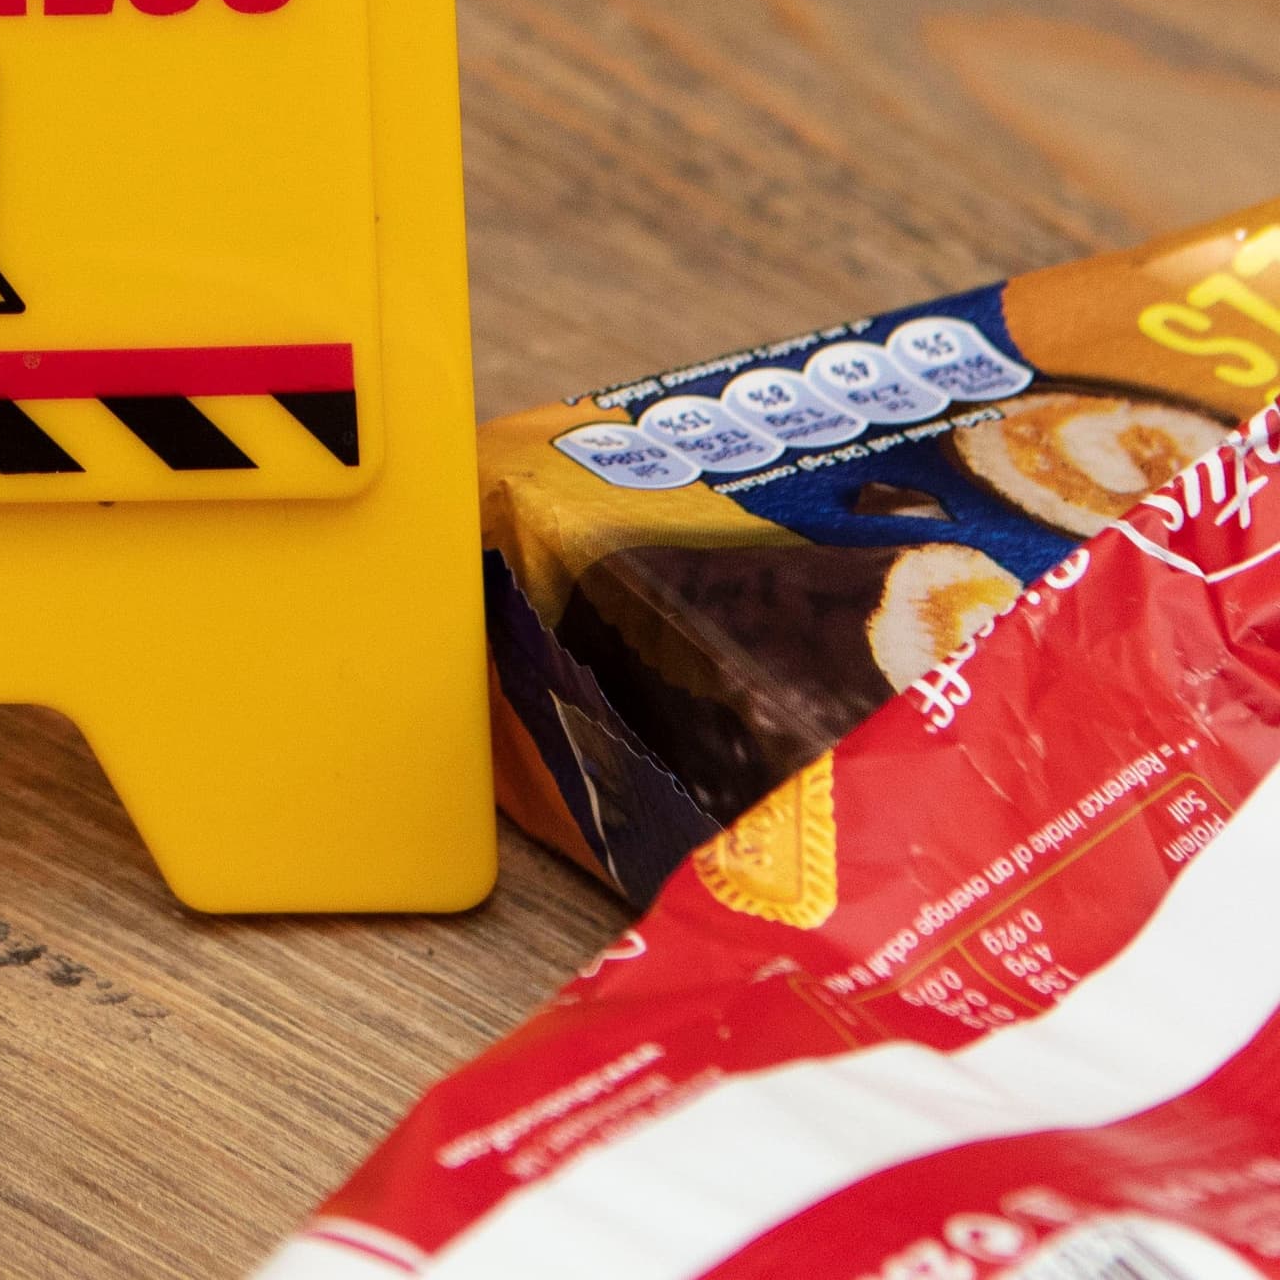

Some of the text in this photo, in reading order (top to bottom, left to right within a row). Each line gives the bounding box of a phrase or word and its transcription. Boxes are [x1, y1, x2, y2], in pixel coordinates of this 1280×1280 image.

[1075, 748, 1167, 821] Reference
[1165, 786, 1209, 827] Salt
[1024, 805, 1087, 857] intake
[980, 853, 1016, 887] an
[1006, 840, 1033, 874] of
[910, 872, 993, 938] average
[863, 925, 922, 981] adult
[976, 907, 1044, 958] 0.92g
